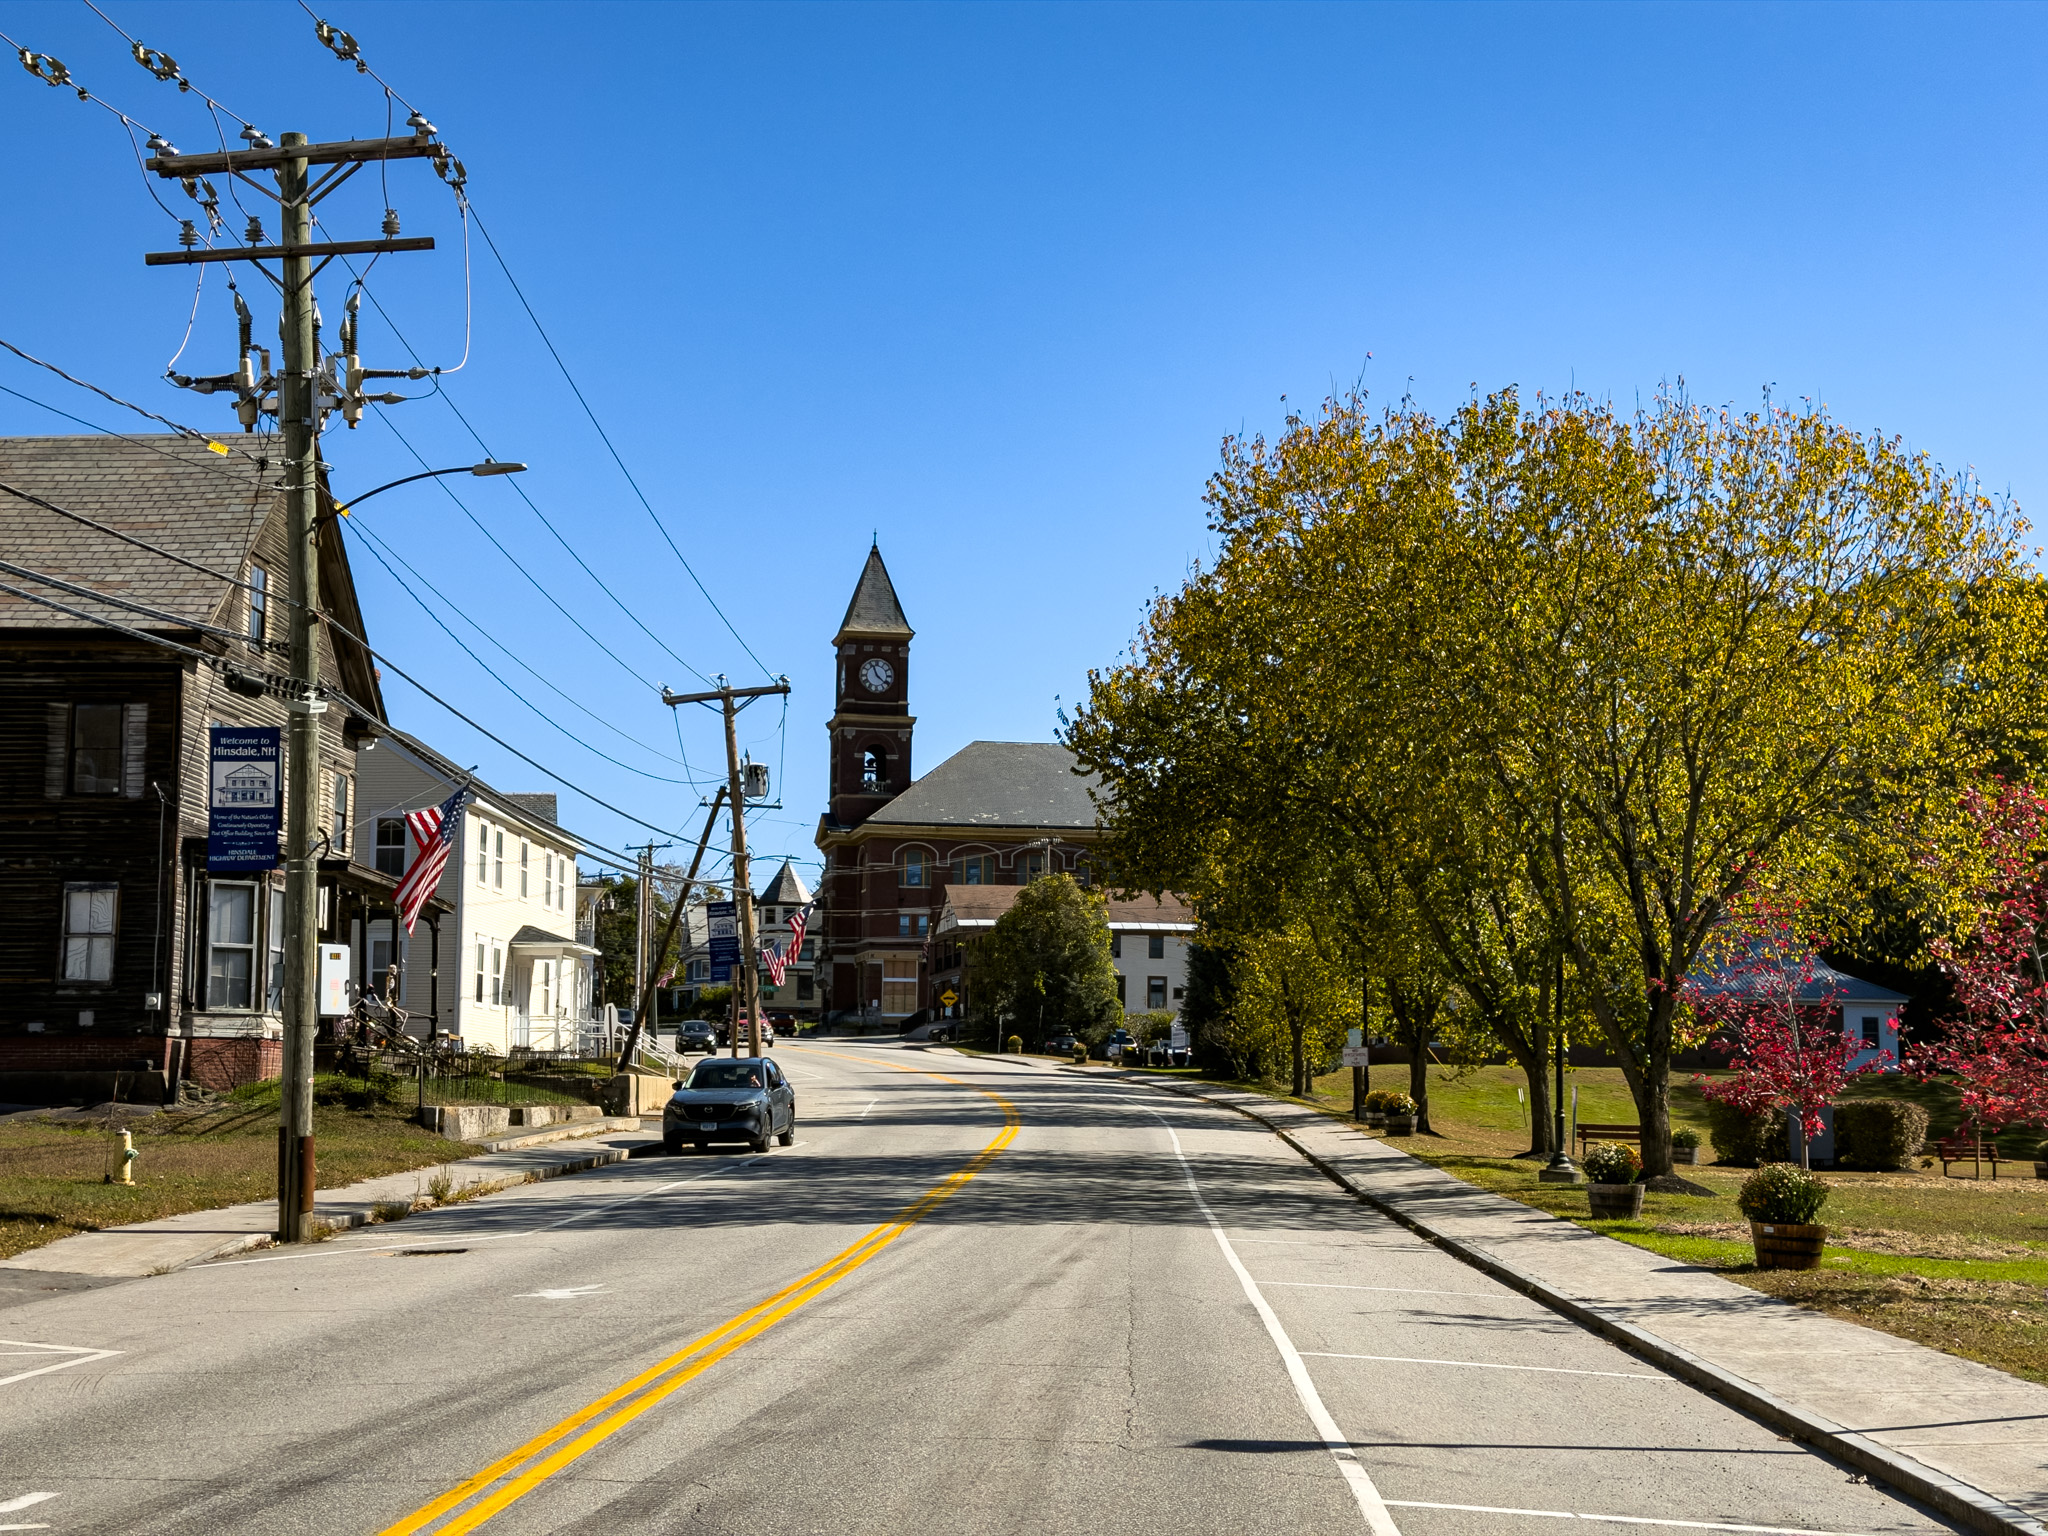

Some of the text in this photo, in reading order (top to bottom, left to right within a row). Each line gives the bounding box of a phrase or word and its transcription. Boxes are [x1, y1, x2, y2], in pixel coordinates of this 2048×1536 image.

[220, 737, 258, 745] Welcome
[213, 746, 276, 757] Hinsdale, NH
